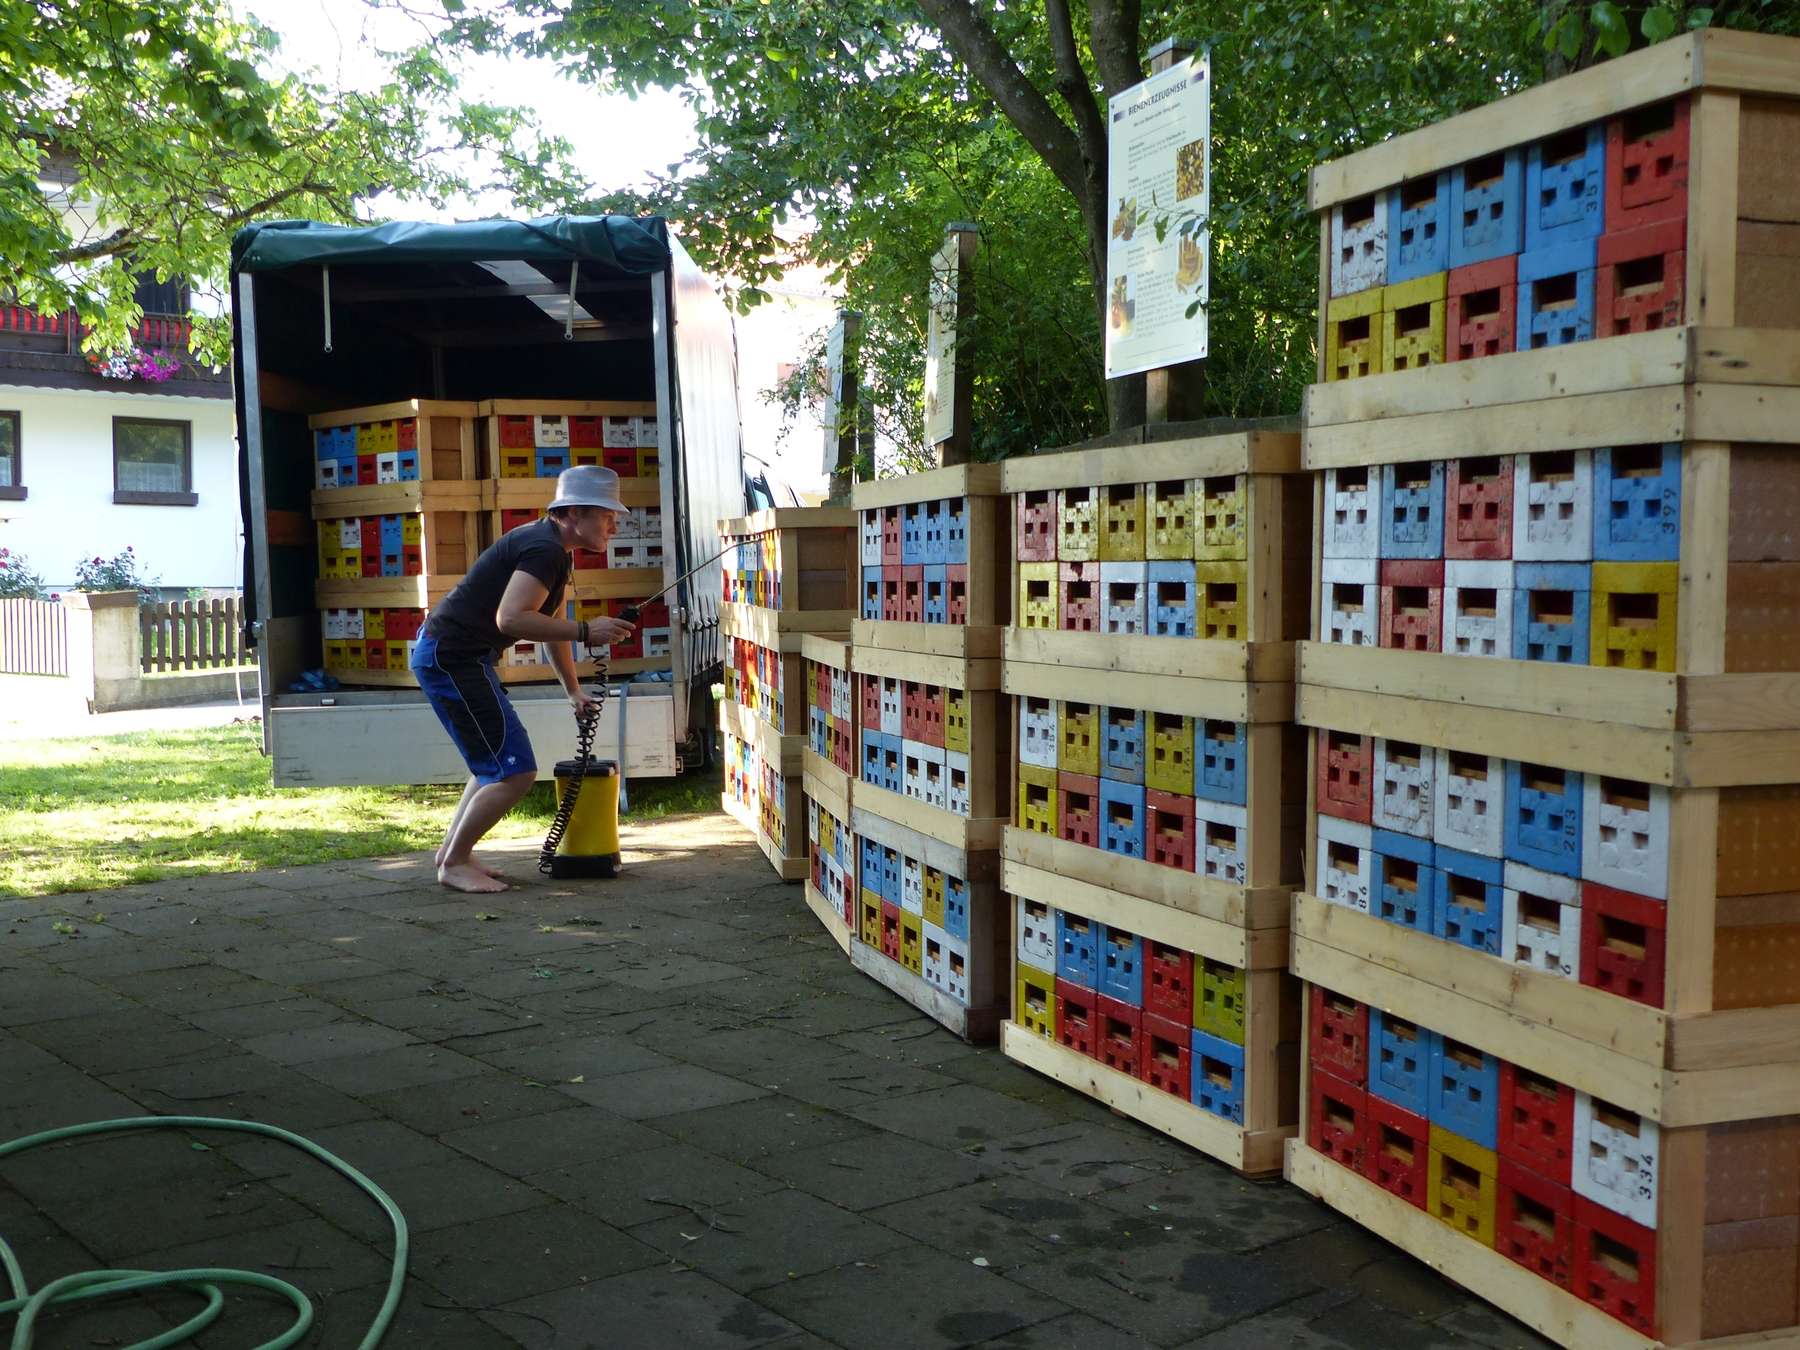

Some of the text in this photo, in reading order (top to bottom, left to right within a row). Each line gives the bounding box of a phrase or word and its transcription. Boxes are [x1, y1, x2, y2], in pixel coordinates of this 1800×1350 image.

[1585, 169, 1598, 212] 351
[1662, 488, 1676, 534] 399
[1562, 809, 1576, 852] 283
[1358, 886, 1367, 909] 86
